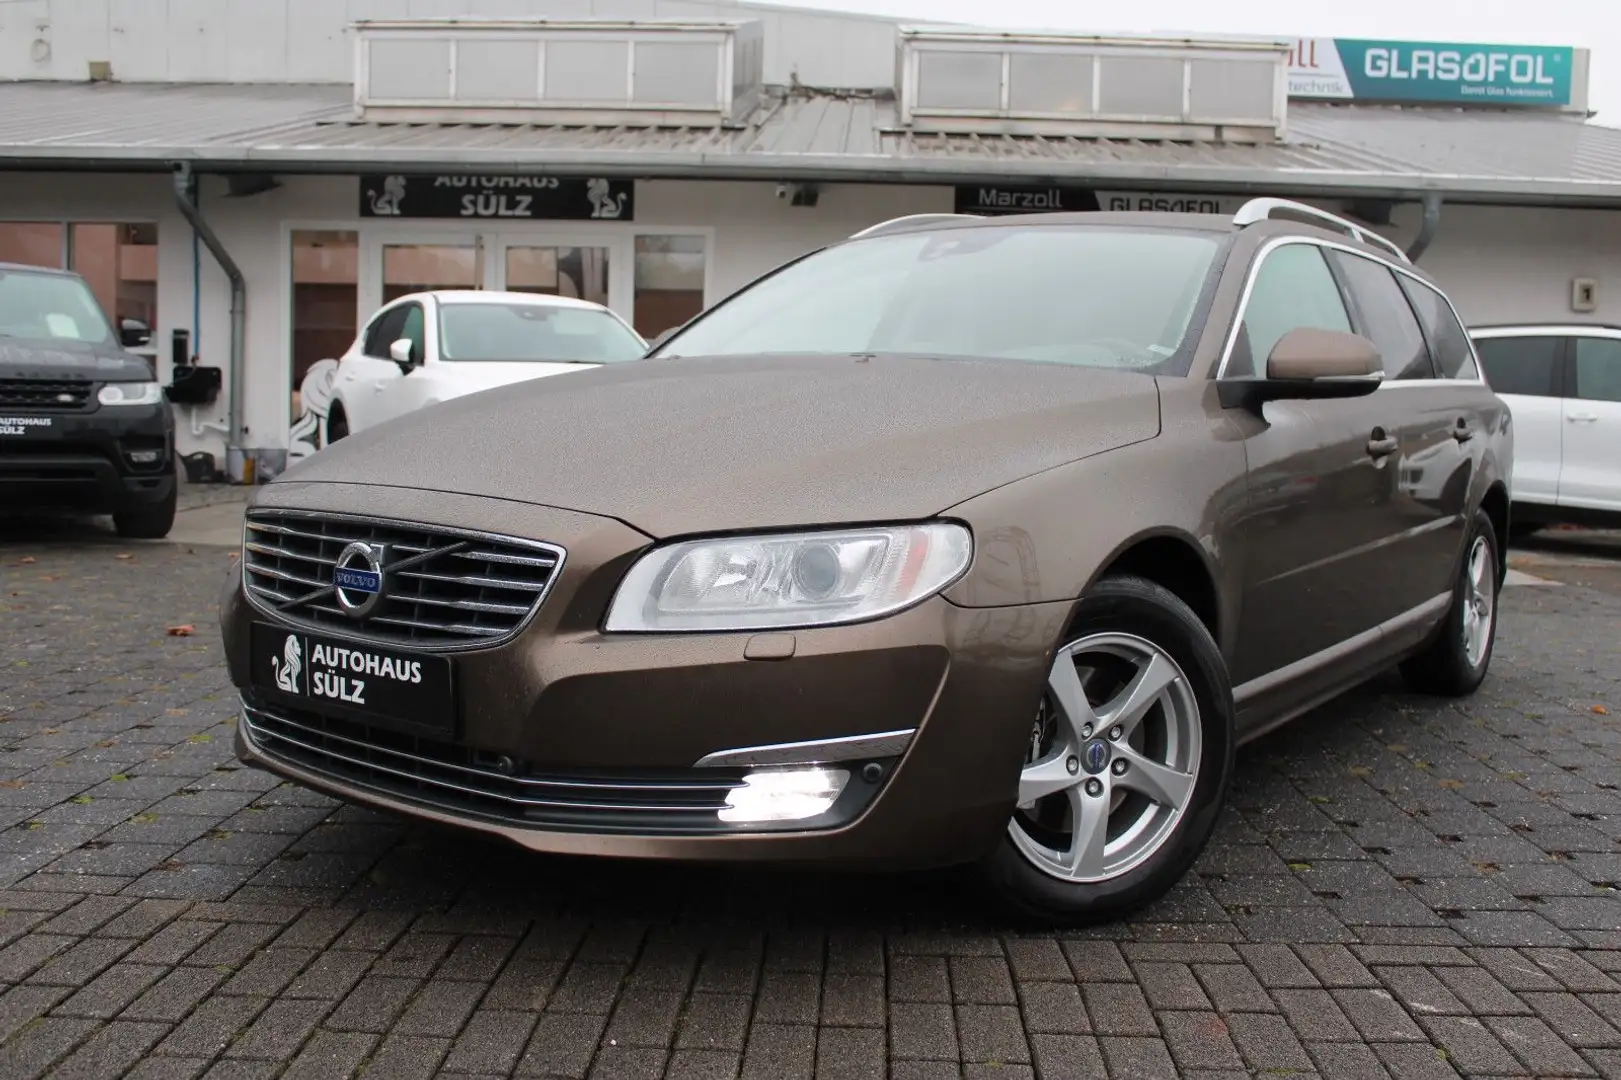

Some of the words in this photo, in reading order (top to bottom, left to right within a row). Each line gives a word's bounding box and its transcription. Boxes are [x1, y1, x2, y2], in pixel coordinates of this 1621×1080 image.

[1364, 48, 1554, 84] GLASOFOL
[460, 189, 533, 216] SÜLZ
[978, 188, 1063, 208] Marzoll
[335, 571, 376, 588] VOLVO
[311, 644, 422, 684] AUTOHAUS
[313, 669, 366, 705] SÜLZ
